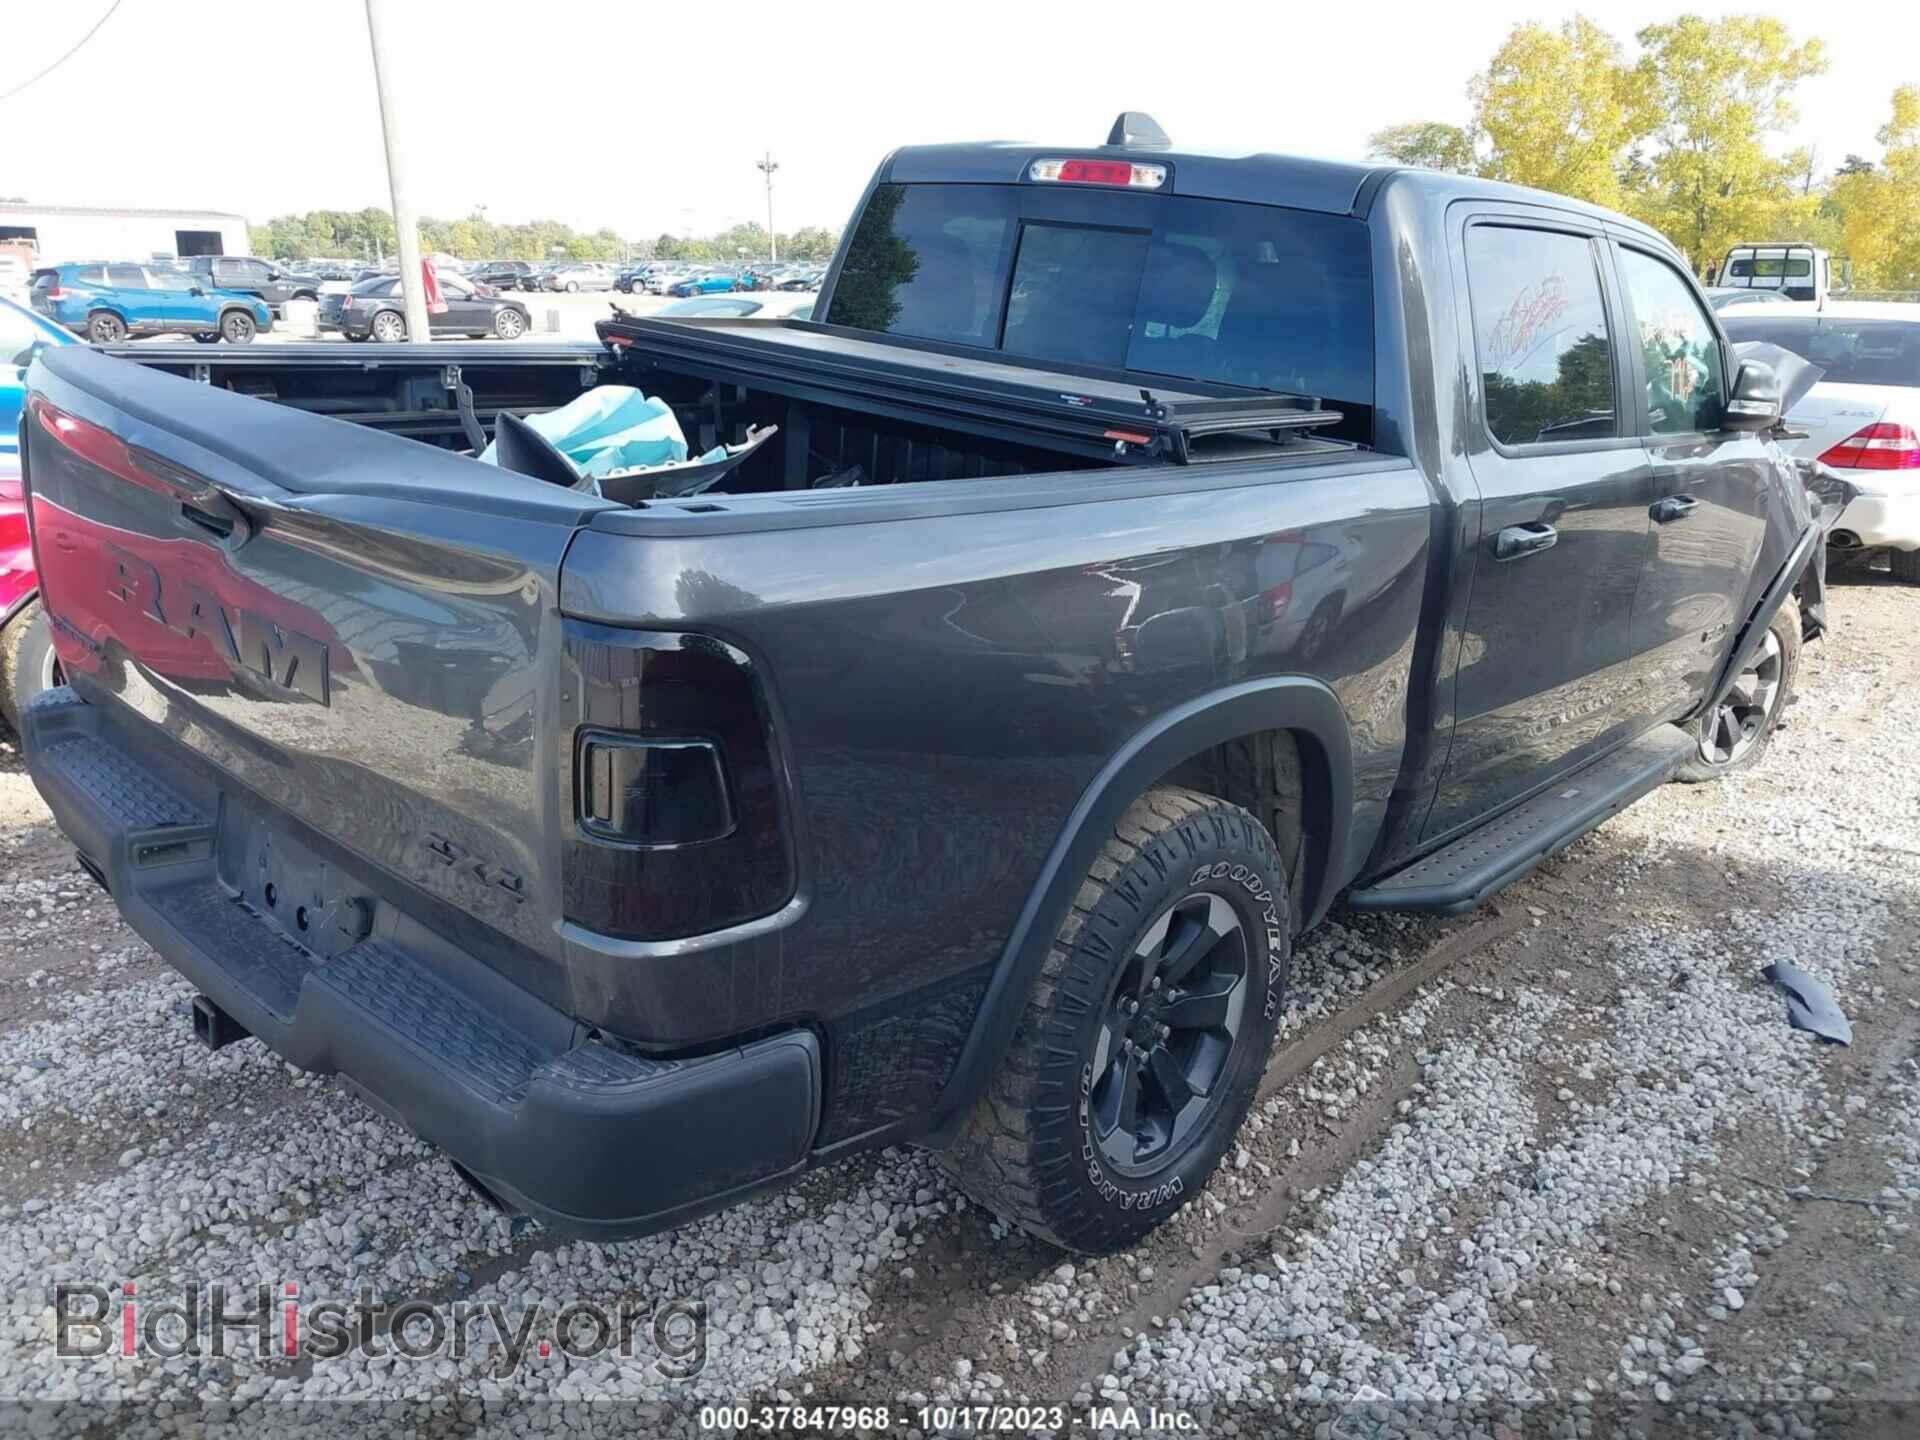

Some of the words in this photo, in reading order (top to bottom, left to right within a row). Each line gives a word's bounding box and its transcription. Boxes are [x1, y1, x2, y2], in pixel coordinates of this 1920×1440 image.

[104, 541, 331, 708] RAM
[1190, 861, 1281, 1020] GOODYEAR
[1079, 1062, 1184, 1210] WRANGLER
